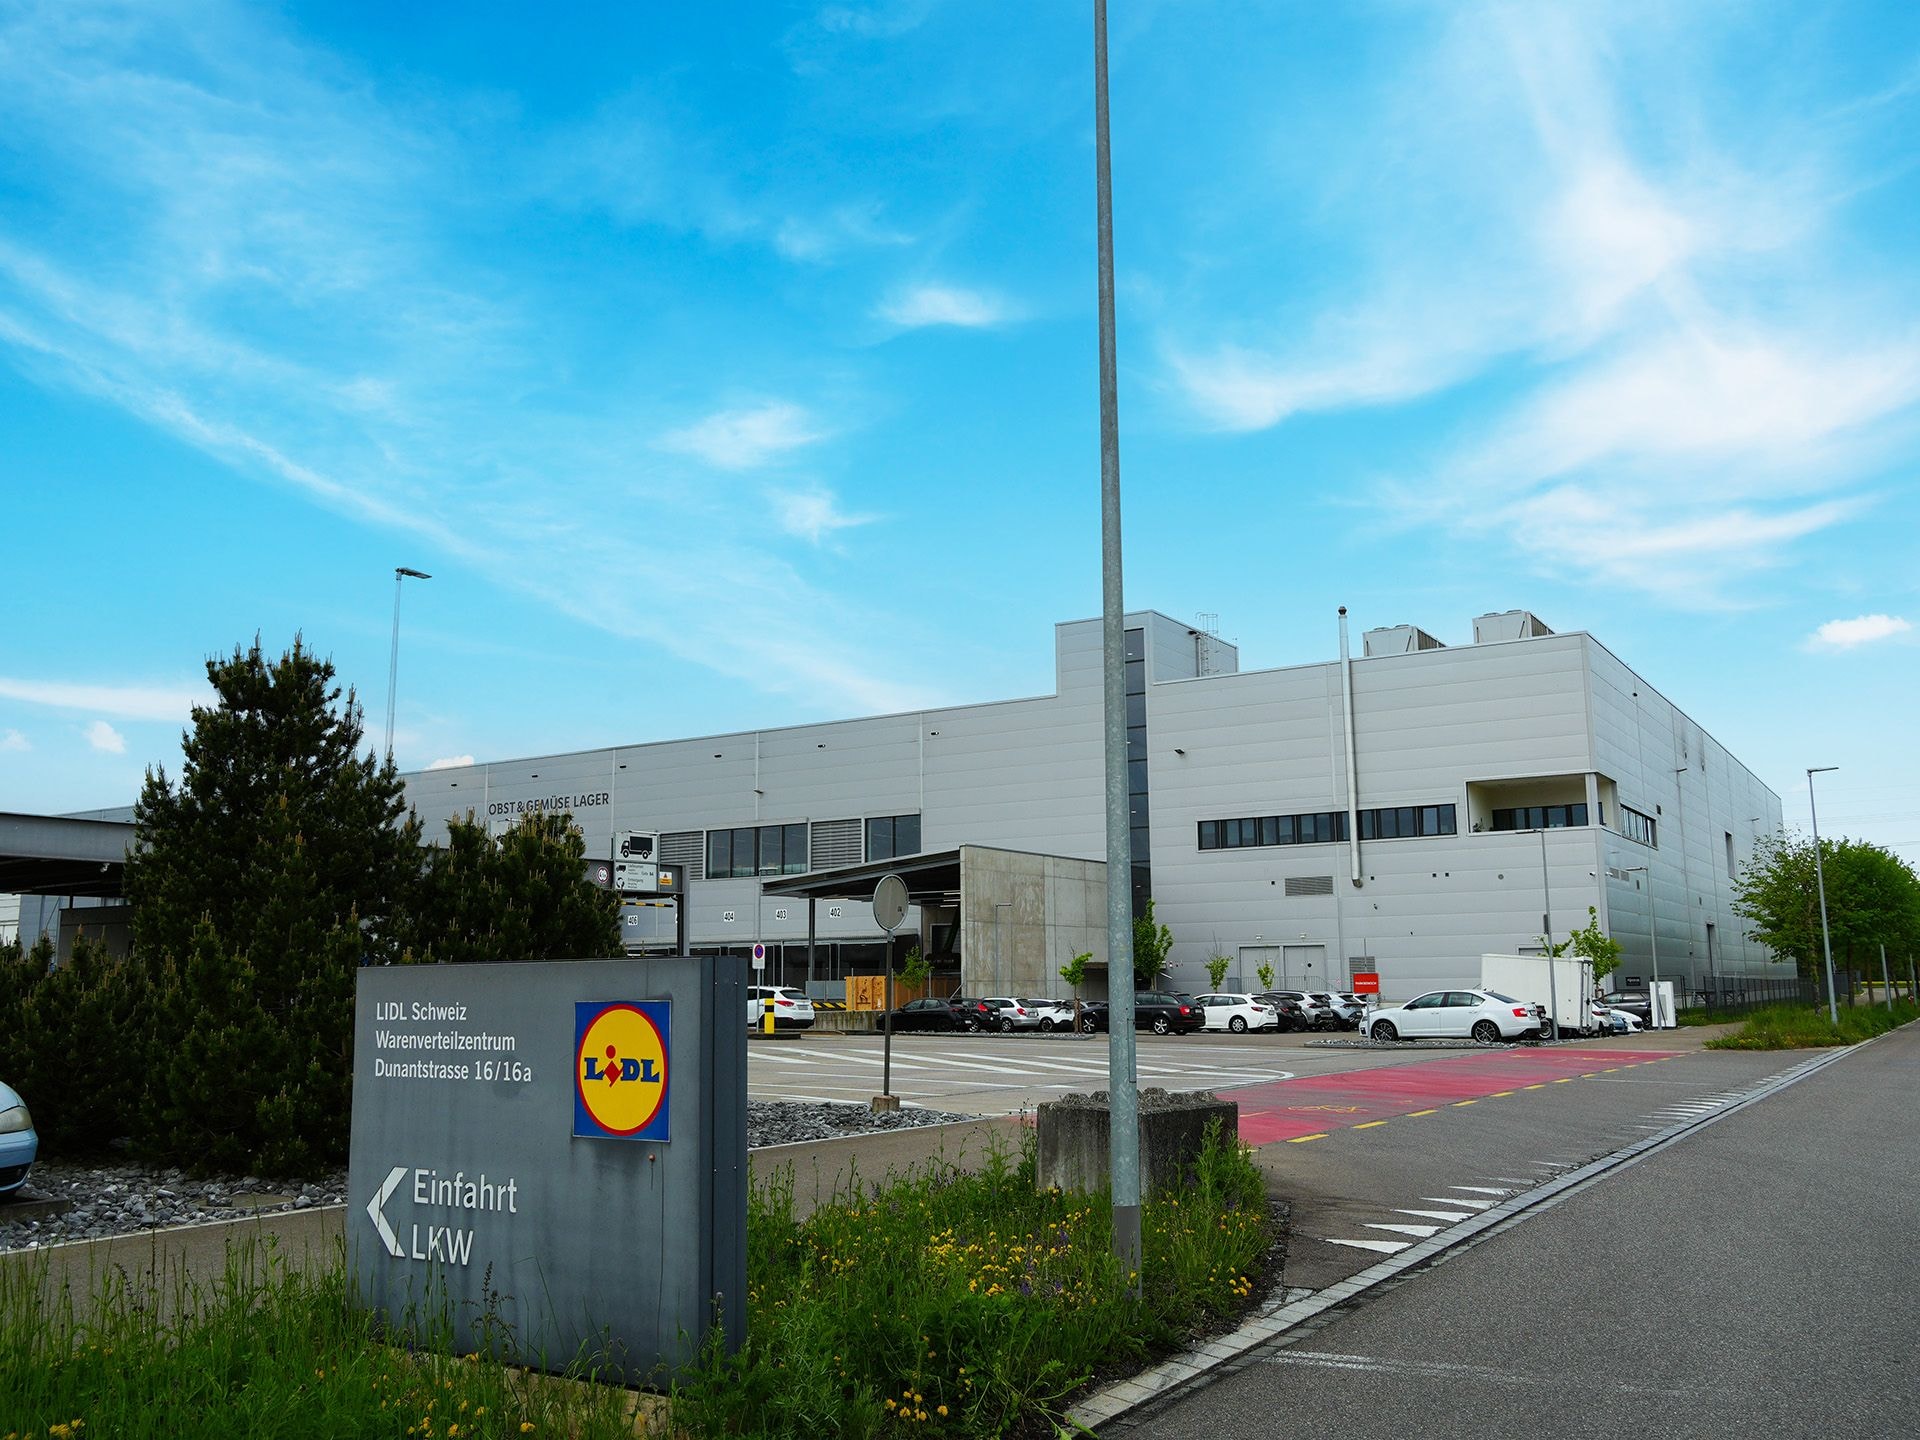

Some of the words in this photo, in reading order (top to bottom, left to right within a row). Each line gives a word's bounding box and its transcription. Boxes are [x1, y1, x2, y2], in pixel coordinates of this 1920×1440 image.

[488, 801, 516, 815] OBST
[574, 792, 609, 808] LAGER
[724, 912, 734, 921] 404
[776, 909, 787, 919] 403
[830, 907, 841, 917] 402
[376, 1002, 408, 1021] LIDL
[411, 1002, 468, 1021] Schweiz
[375, 1030, 516, 1051] Warenverteilzentrum
[375, 1058, 470, 1080] Dunantstrasse
[474, 1060, 533, 1082] 16/16a
[413, 1168, 518, 1214] Einfahrt
[411, 1223, 475, 1267] LKW
